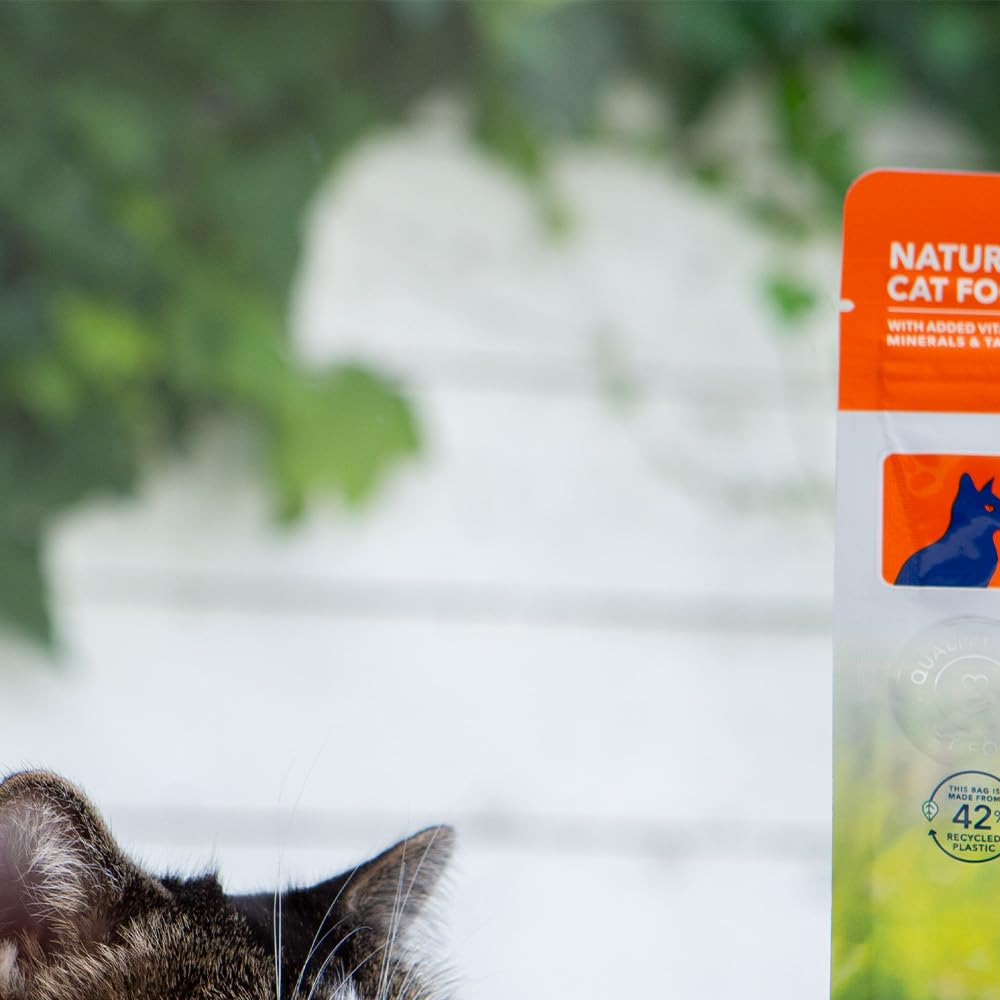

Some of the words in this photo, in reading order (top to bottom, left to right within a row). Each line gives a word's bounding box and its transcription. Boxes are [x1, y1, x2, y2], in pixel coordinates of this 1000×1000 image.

[887, 275, 949, 303] CAT
[887, 319, 924, 333] WITH
[926, 320, 976, 334] ADDED
[886, 335, 965, 347] MINERALS
[969, 337, 980, 348] &
[949, 785, 968, 793] THIS
[948, 793, 973, 801] MADE
[947, 833, 1000, 843] RECYCLED
[952, 843, 996, 852] PLASTIC
